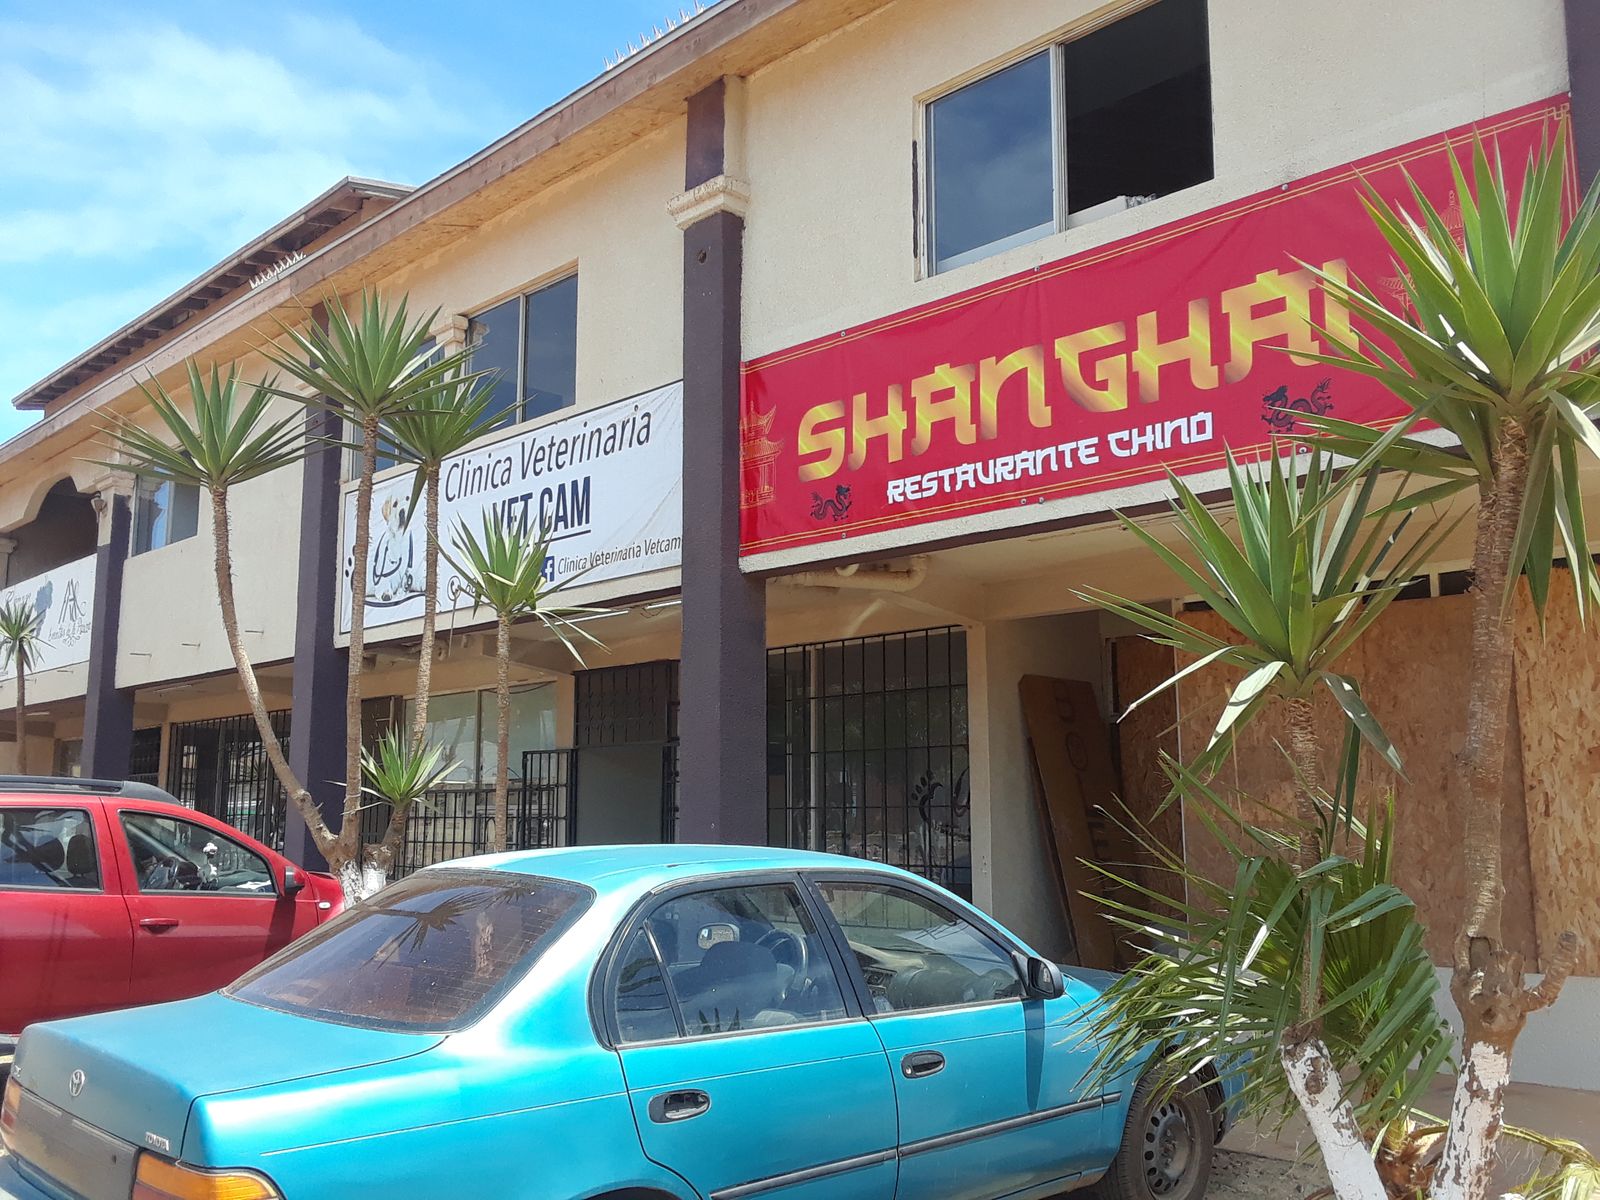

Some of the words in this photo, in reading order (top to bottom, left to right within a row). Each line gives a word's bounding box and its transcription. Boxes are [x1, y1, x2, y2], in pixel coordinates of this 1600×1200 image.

[798, 258, 1360, 483] SHANGHAI
[445, 453, 513, 502] Clinica
[520, 404, 652, 480] Veterinaria
[886, 437, 1099, 504] RESTAURANTE
[1107, 411, 1213, 457] CHINO
[539, 476, 591, 535] CAM
[558, 556, 587, 575] Clinica
[590, 542, 641, 568] Veterinaria
[645, 536, 681, 556] Vetcam
